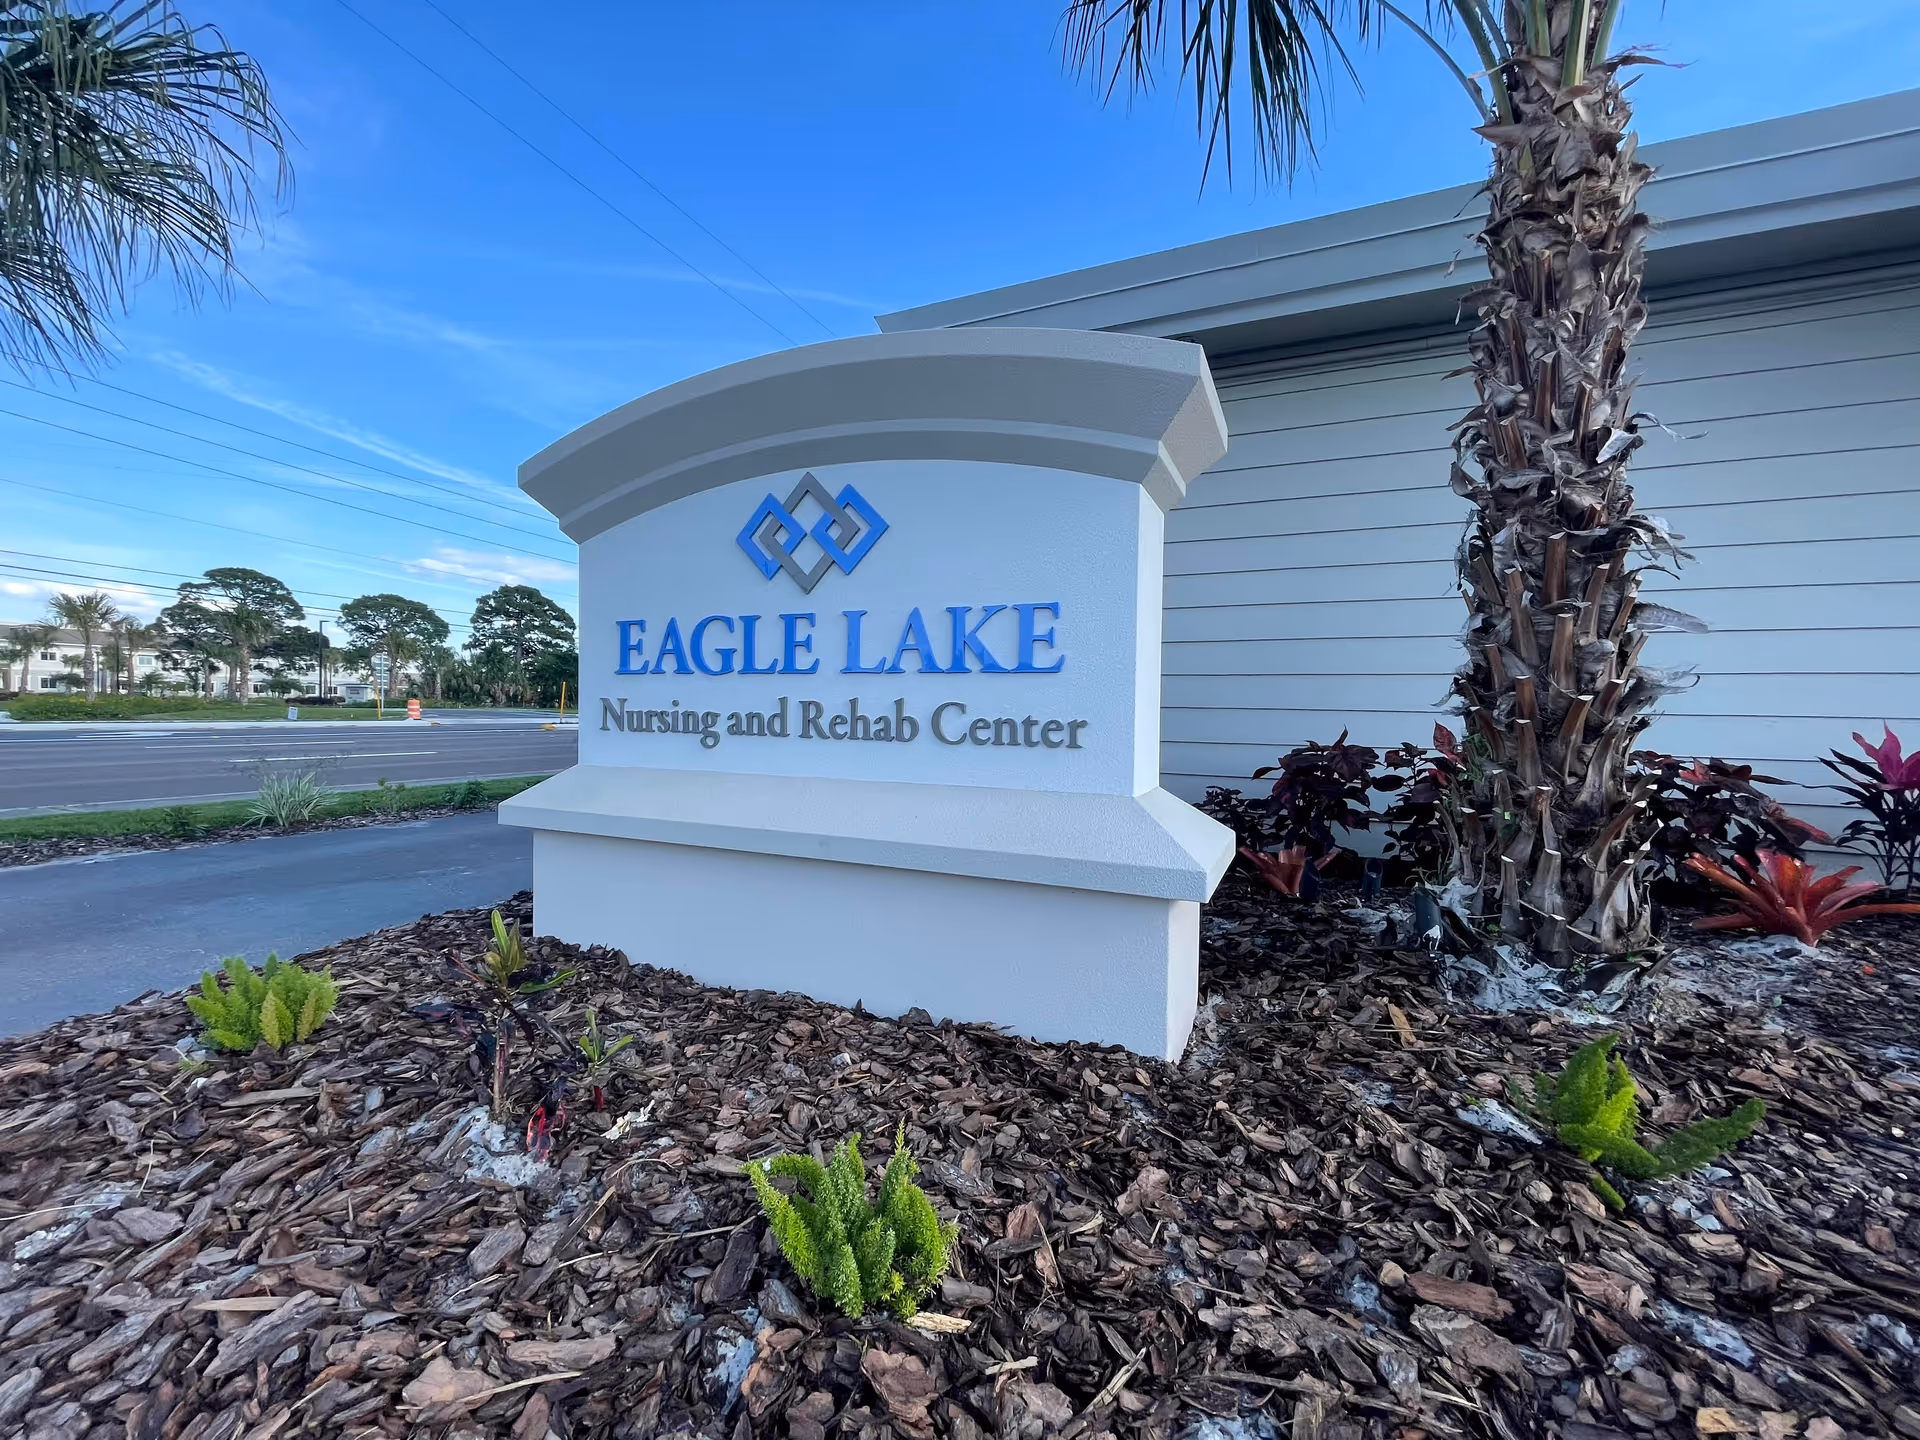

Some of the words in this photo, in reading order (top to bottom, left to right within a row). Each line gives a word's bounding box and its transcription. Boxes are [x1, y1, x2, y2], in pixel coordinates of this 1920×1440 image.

[615, 612, 821, 676] EAGLE
[839, 601, 1065, 674] LAKE
[599, 697, 721, 749] Nursing
[726, 696, 790, 738] and
[798, 698, 920, 743] Rehab
[930, 701, 1088, 749] Center
